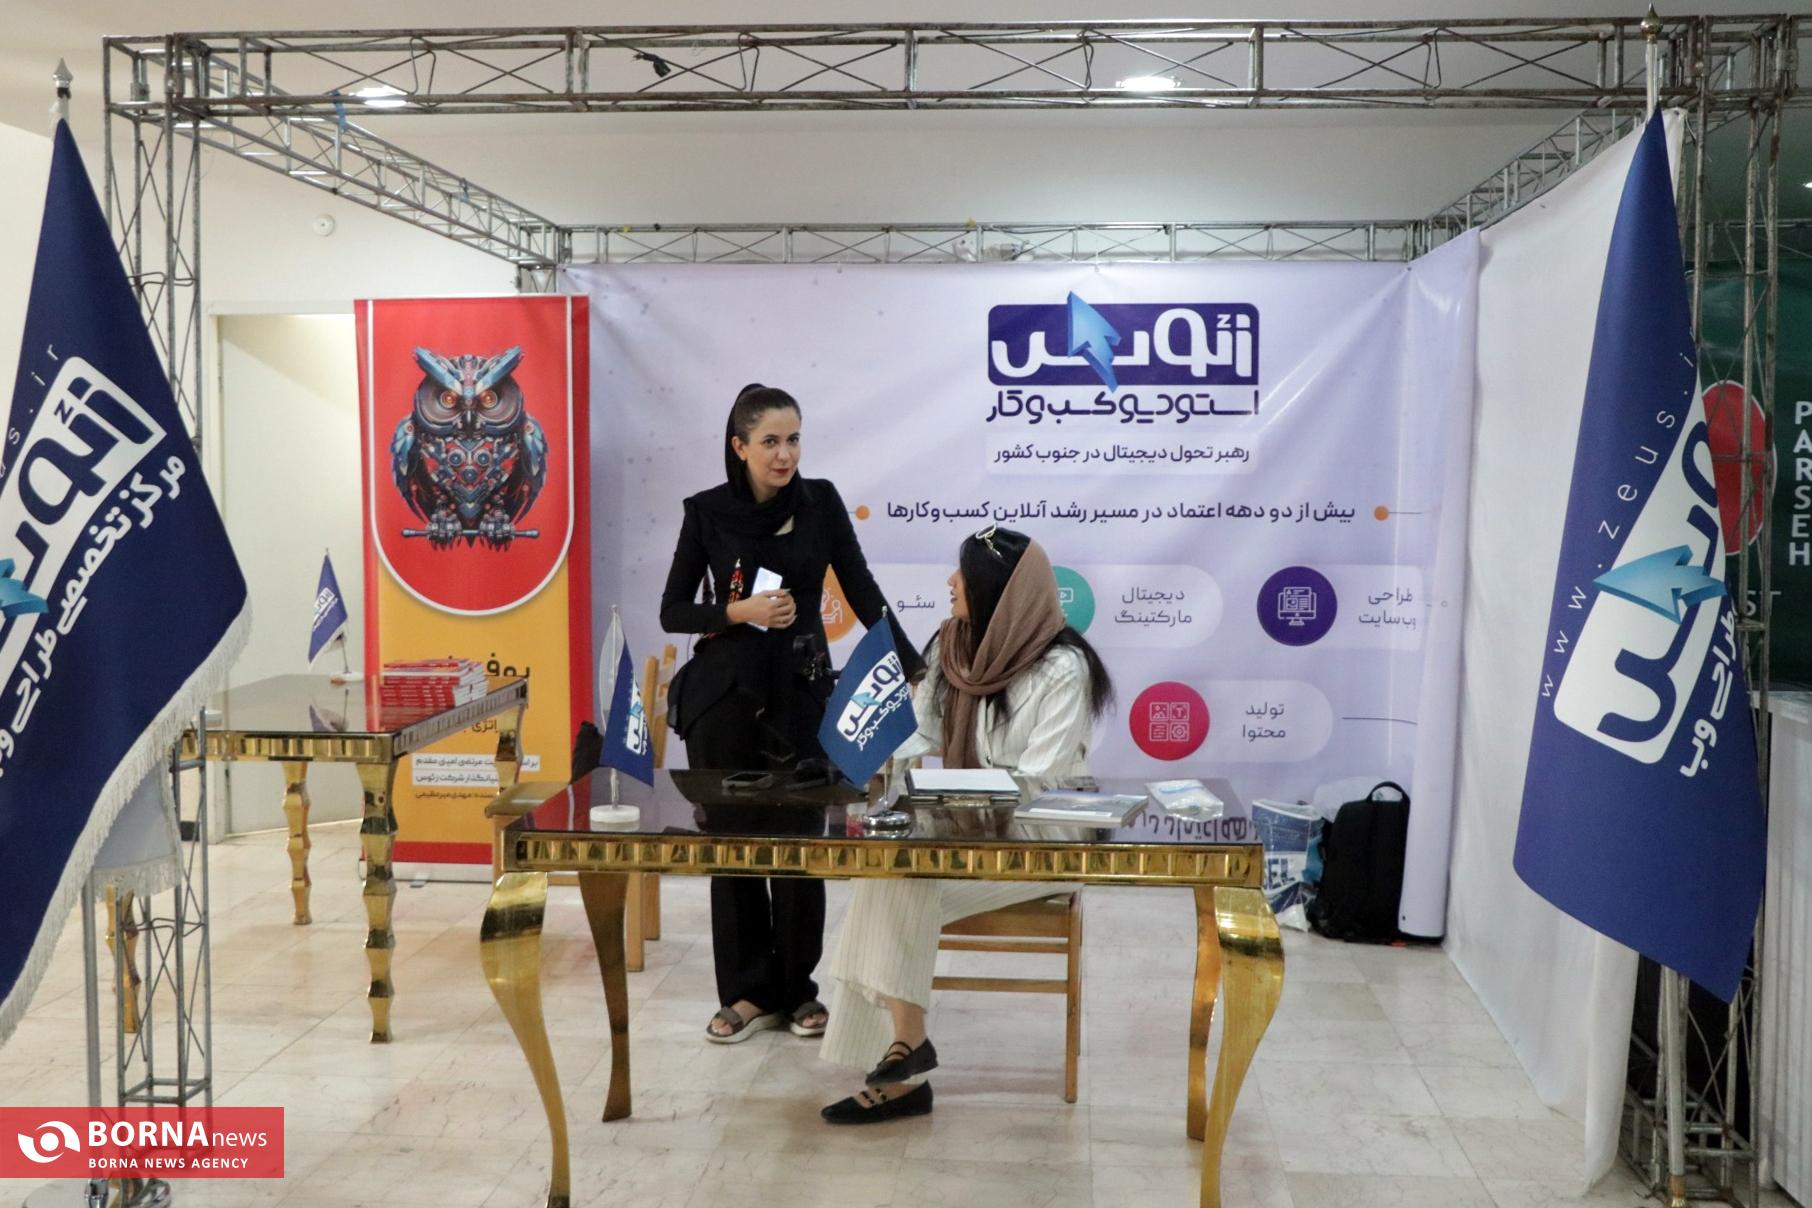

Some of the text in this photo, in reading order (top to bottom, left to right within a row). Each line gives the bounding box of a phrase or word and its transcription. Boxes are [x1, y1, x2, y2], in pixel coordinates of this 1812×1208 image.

[994, 444, 1250, 464] رهبر تحول دیجیتال در جنوب کشور
[119, 455, 187, 529] مرکز
[994, 500, 1046, 522] آنلاین
[1051, 501, 1086, 522] رشد
[1090, 507, 1139, 523] مسیر
[1142, 505, 1162, 523] در
[1167, 502, 1221, 518] اعتماد
[1225, 503, 1265, 518] دهه
[1270, 504, 1293, 523] دو
[1296, 502, 1310, 523] از
[1313, 501, 1355, 523] بیش
[57, 505, 133, 635] تخصصی
[897, 596, 936, 612] سئو
[1121, 587, 1186, 605] دیجیتال
[1368, 588, 1413, 605] طراحی
[1114, 610, 1193, 627] مارکتینگ
[12, 628, 57, 734] طراحی
[1245, 703, 1286, 719] تولید
[1241, 725, 1287, 742] محتوا
